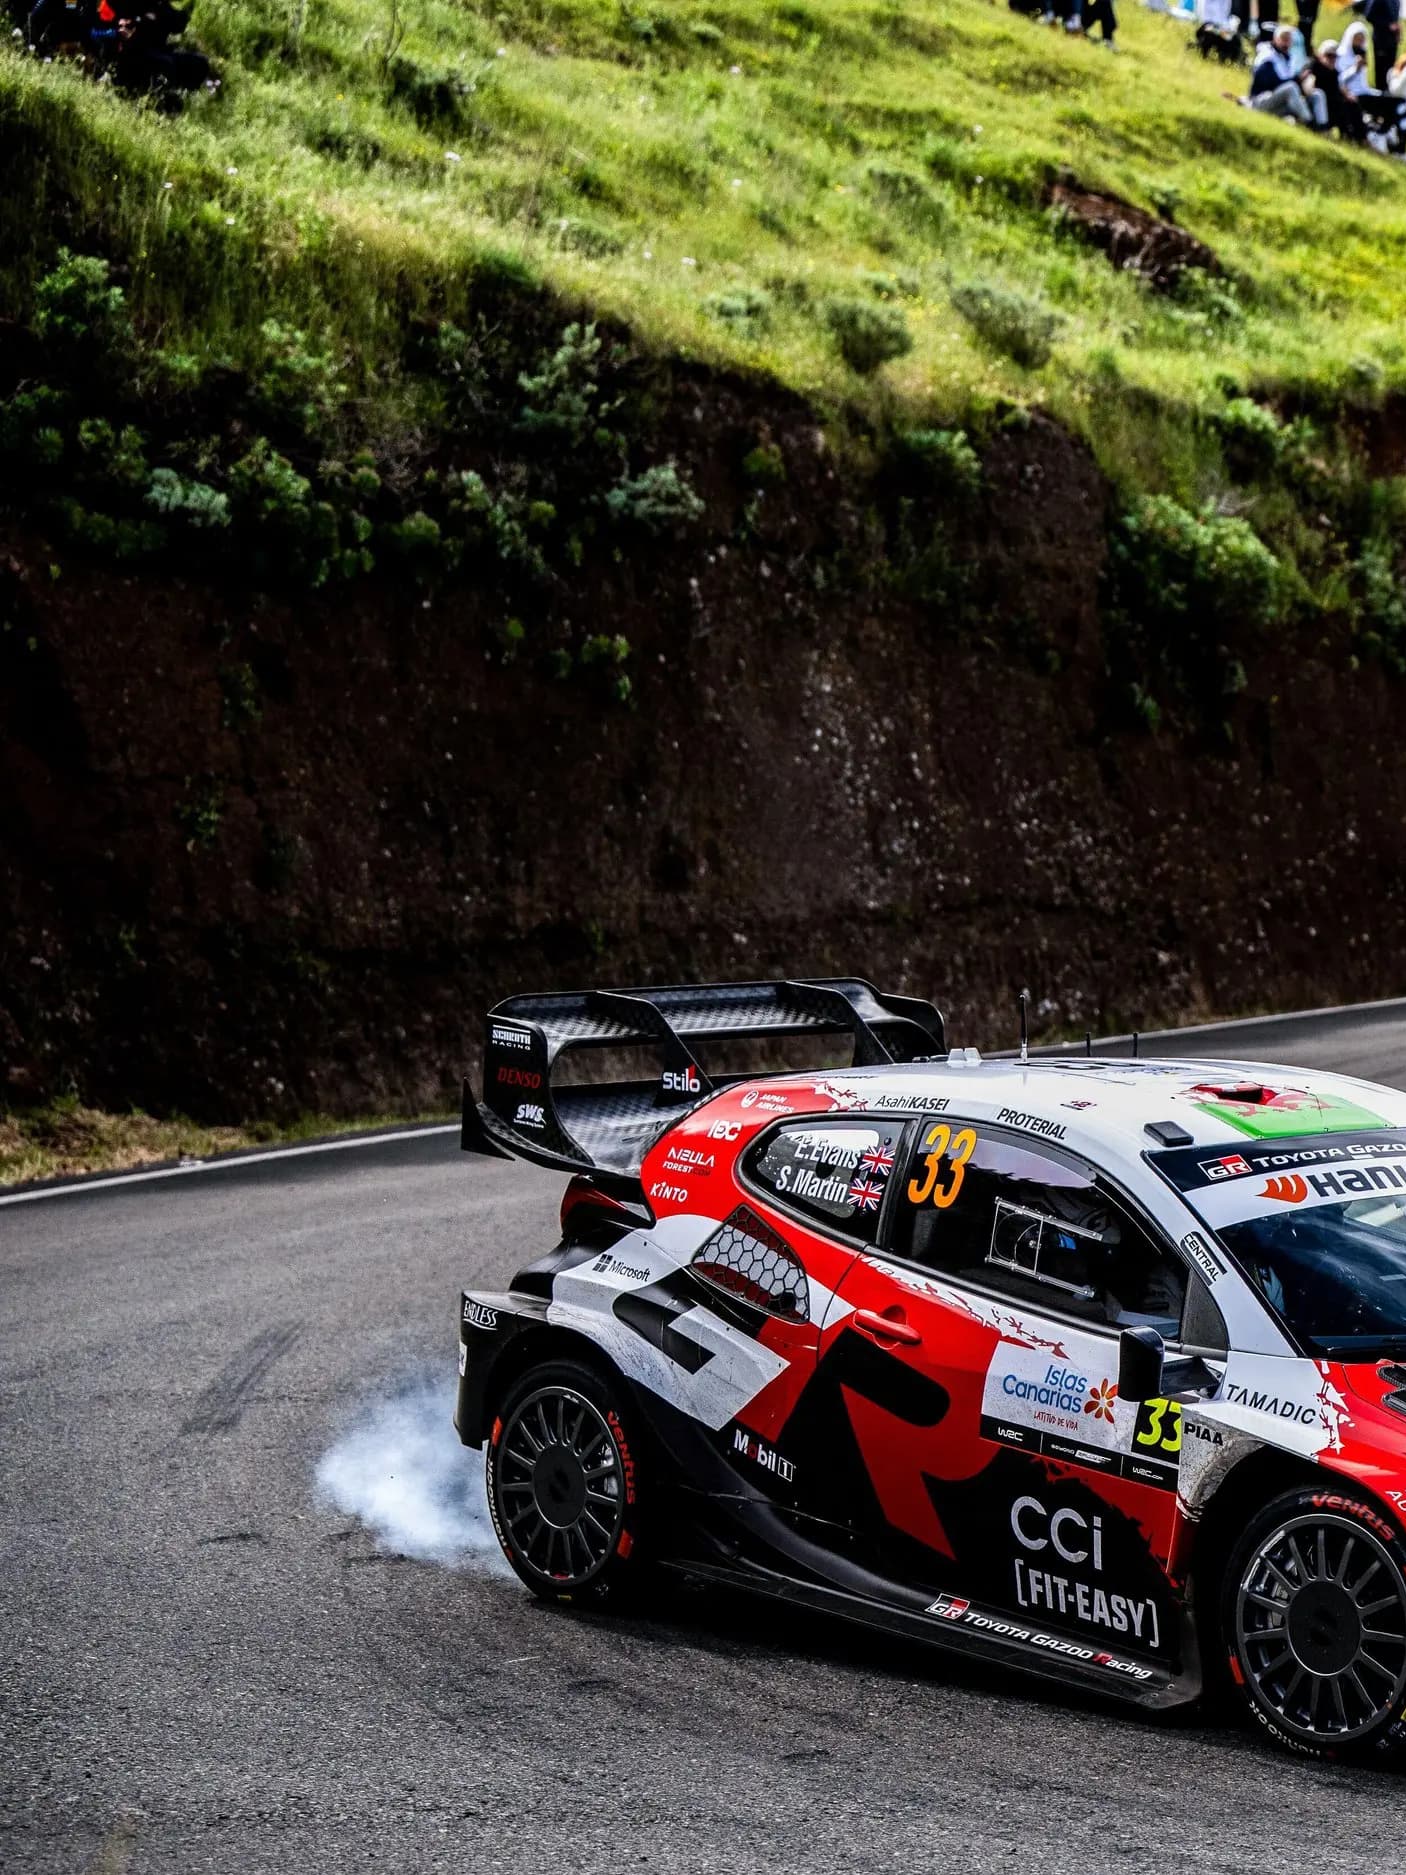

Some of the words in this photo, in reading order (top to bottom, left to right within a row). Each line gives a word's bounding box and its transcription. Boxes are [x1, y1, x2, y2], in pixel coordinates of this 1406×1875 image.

[492, 1040, 531, 1051] RACING
[498, 1067, 541, 1089] DENSO
[662, 1065, 701, 1093] Stilo
[516, 1103, 545, 1122] SWS
[996, 1108, 1067, 1140] PROTERIAL
[907, 1124, 978, 1209] 33
[1204, 1157, 1250, 1180] GR
[1252, 1147, 1343, 1168] TOYOTA
[776, 1165, 848, 1204] S.Martin
[607, 1259, 651, 1283] Microsoft
[1183, 1233, 1222, 1282] CENTRAL
[463, 1300, 499, 1328] ENDLESS
[1002, 1374, 1083, 1414] Canarias
[1044, 1364, 1088, 1394] Islas
[1227, 1383, 1317, 1425] TAMADIC
[997, 1426, 1025, 1443] WRC
[1183, 1421, 1224, 1447] PIAA
[733, 1429, 777, 1472] Mobil
[965, 1612, 1028, 1640] TOYOTA
[1030, 1633, 1094, 1660] GAZOO
[1093, 1652, 1153, 1679] Racing
